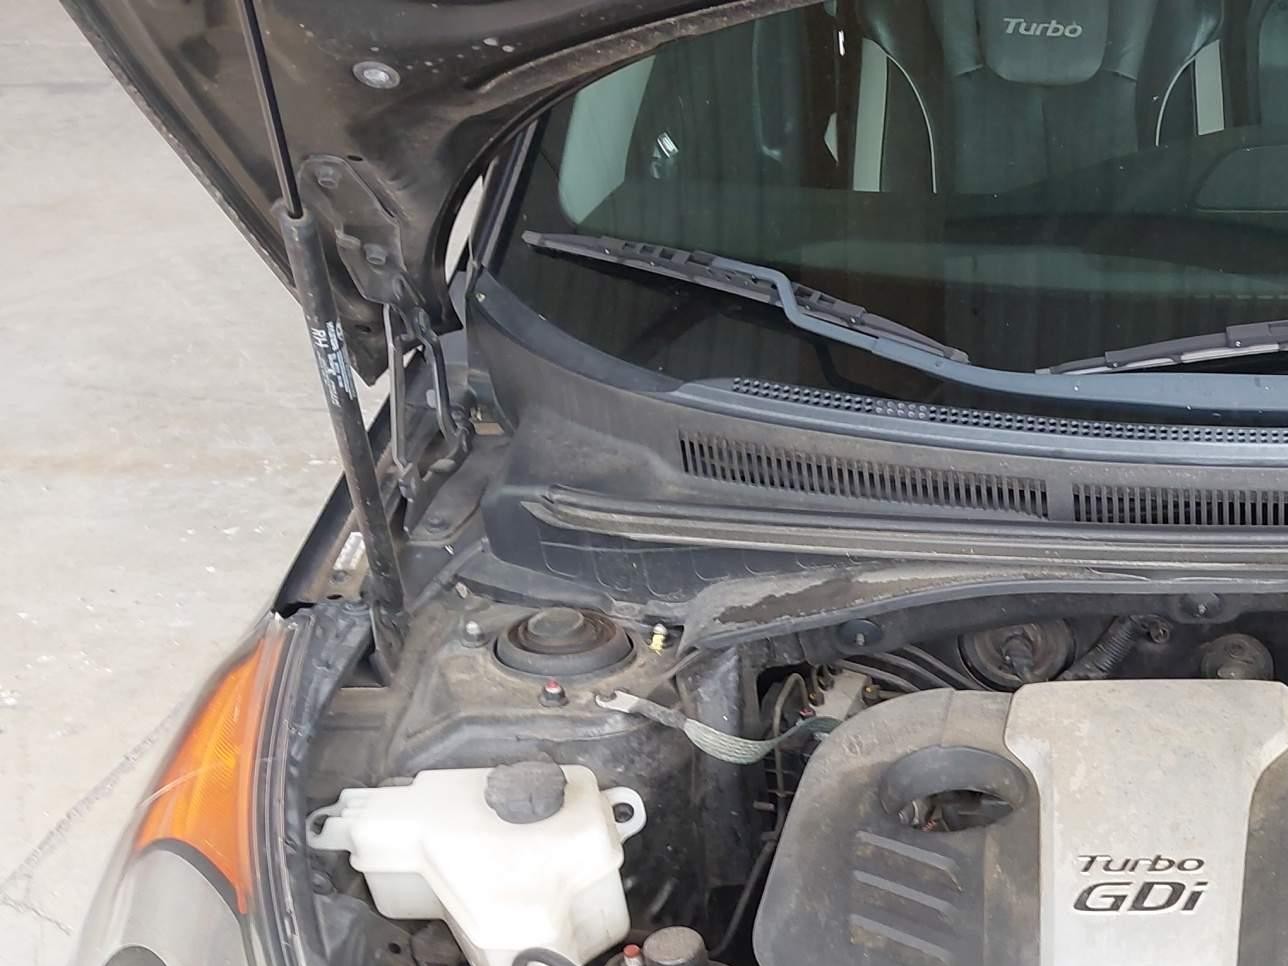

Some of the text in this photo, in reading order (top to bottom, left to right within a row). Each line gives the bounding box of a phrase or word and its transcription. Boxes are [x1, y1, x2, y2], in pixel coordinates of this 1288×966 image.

[1003, 18, 1082, 38] Turbo
[311, 327, 330, 349] RH
[1076, 854, 1205, 873] Turbo
[1073, 881, 1209, 912] GDi
